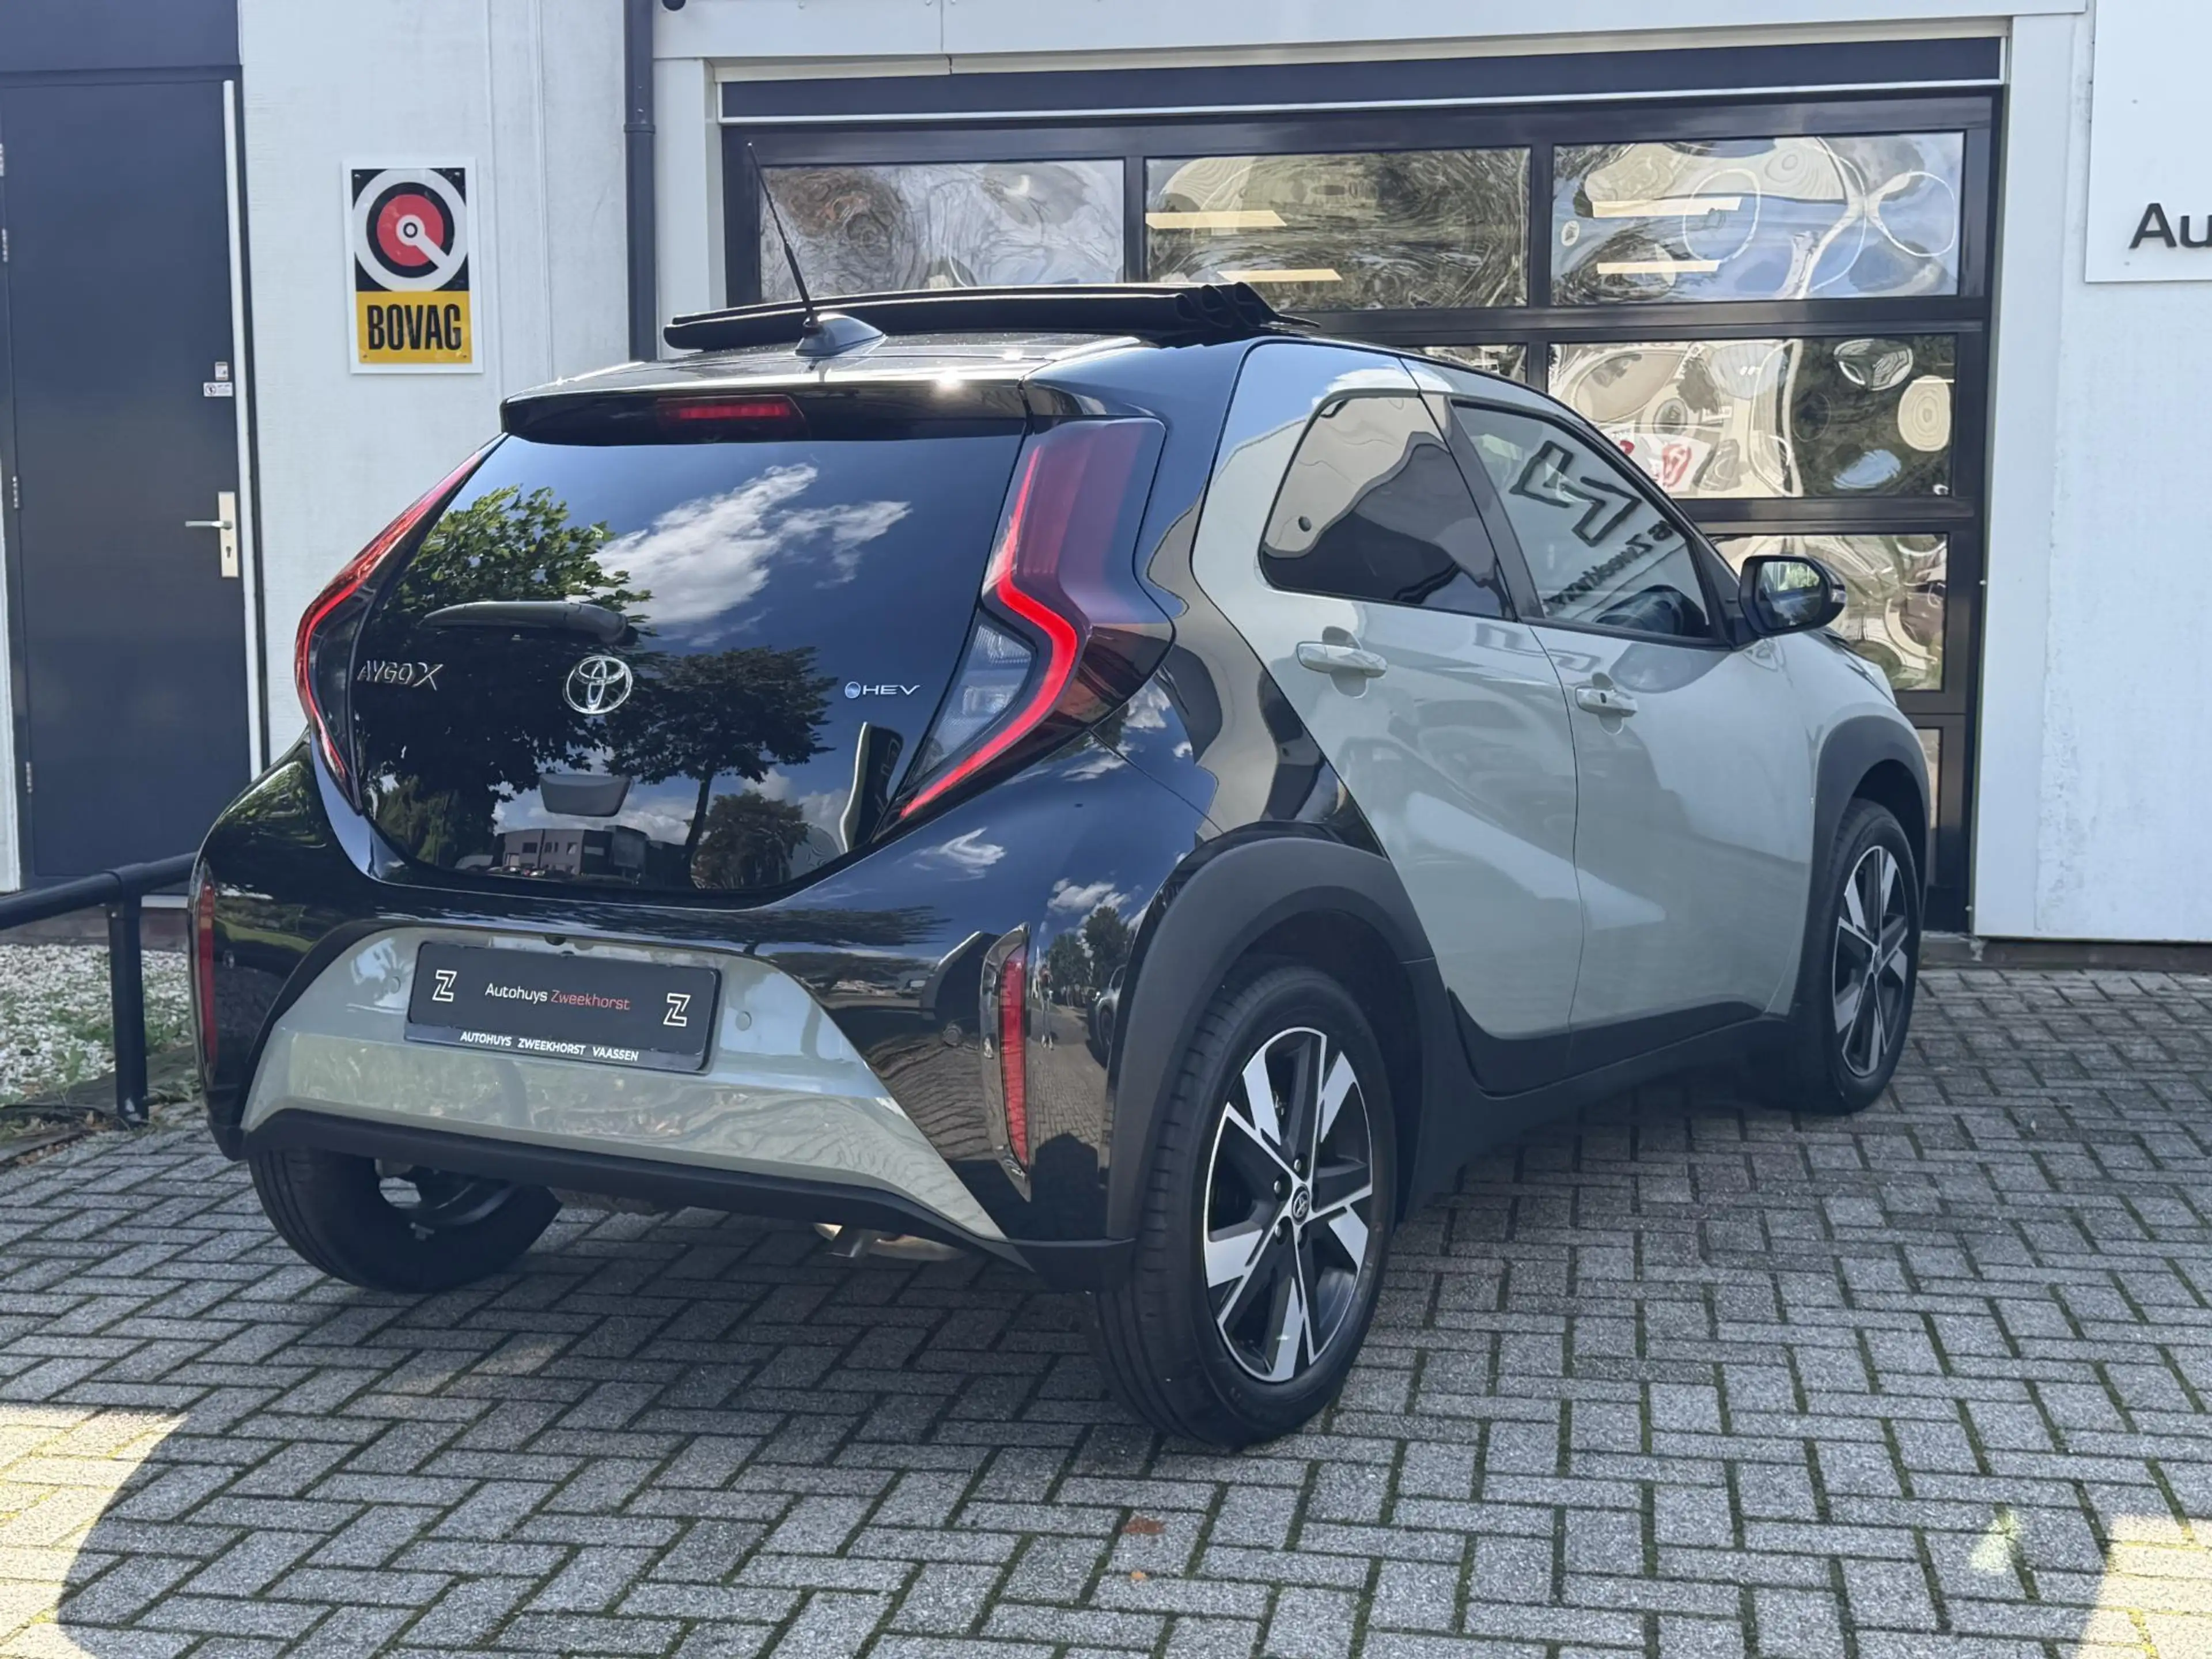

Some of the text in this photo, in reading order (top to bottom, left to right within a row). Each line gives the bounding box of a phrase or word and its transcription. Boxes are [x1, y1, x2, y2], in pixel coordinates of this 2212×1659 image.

[2128, 202, 2212, 248] Au
[367, 304, 461, 351] BOVAG
[862, 685, 921, 695] HEV
[432, 969, 457, 1002] Z
[484, 983, 631, 1010] Autohuys Zweekhorst
[663, 993, 691, 1027] Z
[460, 1031, 639, 1062] AUTOHUYS ZWEEKHORST VAASSEN
